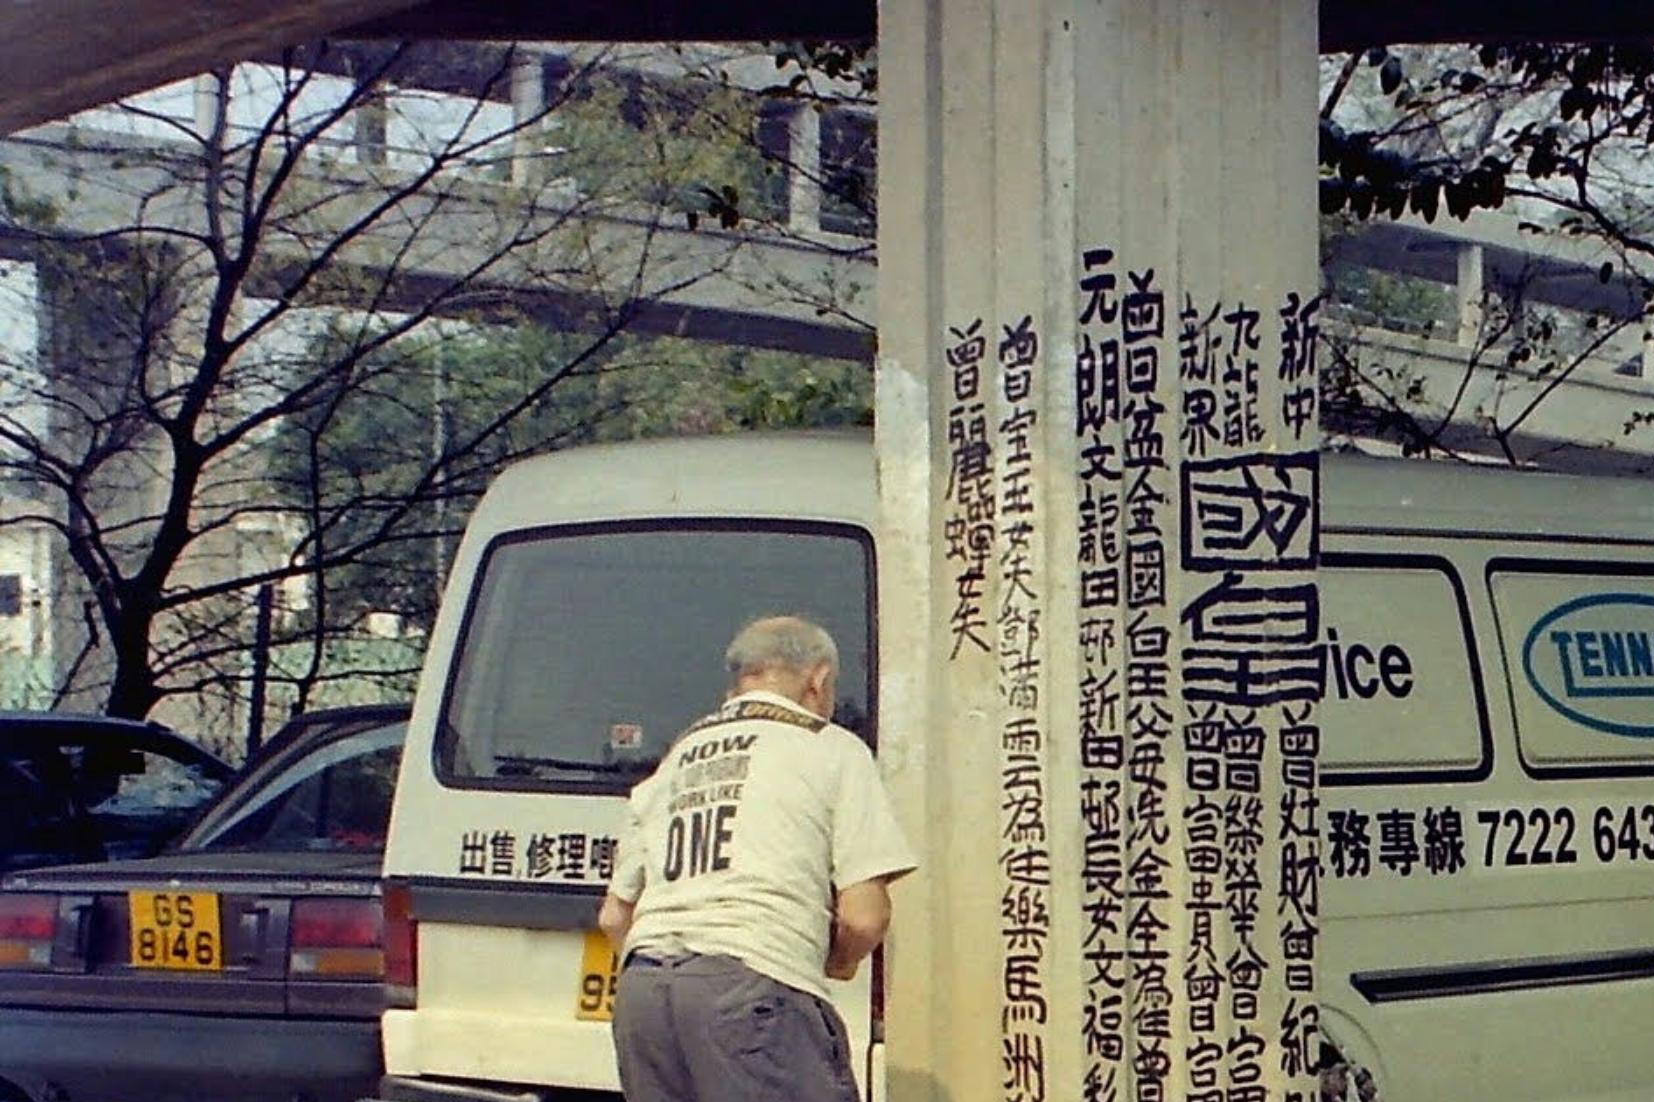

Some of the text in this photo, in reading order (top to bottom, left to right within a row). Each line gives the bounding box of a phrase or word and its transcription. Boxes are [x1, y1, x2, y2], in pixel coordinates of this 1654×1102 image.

[1179, 291, 1222, 457] 新界
[1223, 301, 1266, 448] 九龍
[1180, 452, 1327, 708] 國皇
[679, 734, 759, 769] NOW
[663, 804, 737, 881] ONE
[1477, 807, 1577, 867] 7222
[153, 894, 195, 928] GS
[139, 928, 214, 965] 8146
